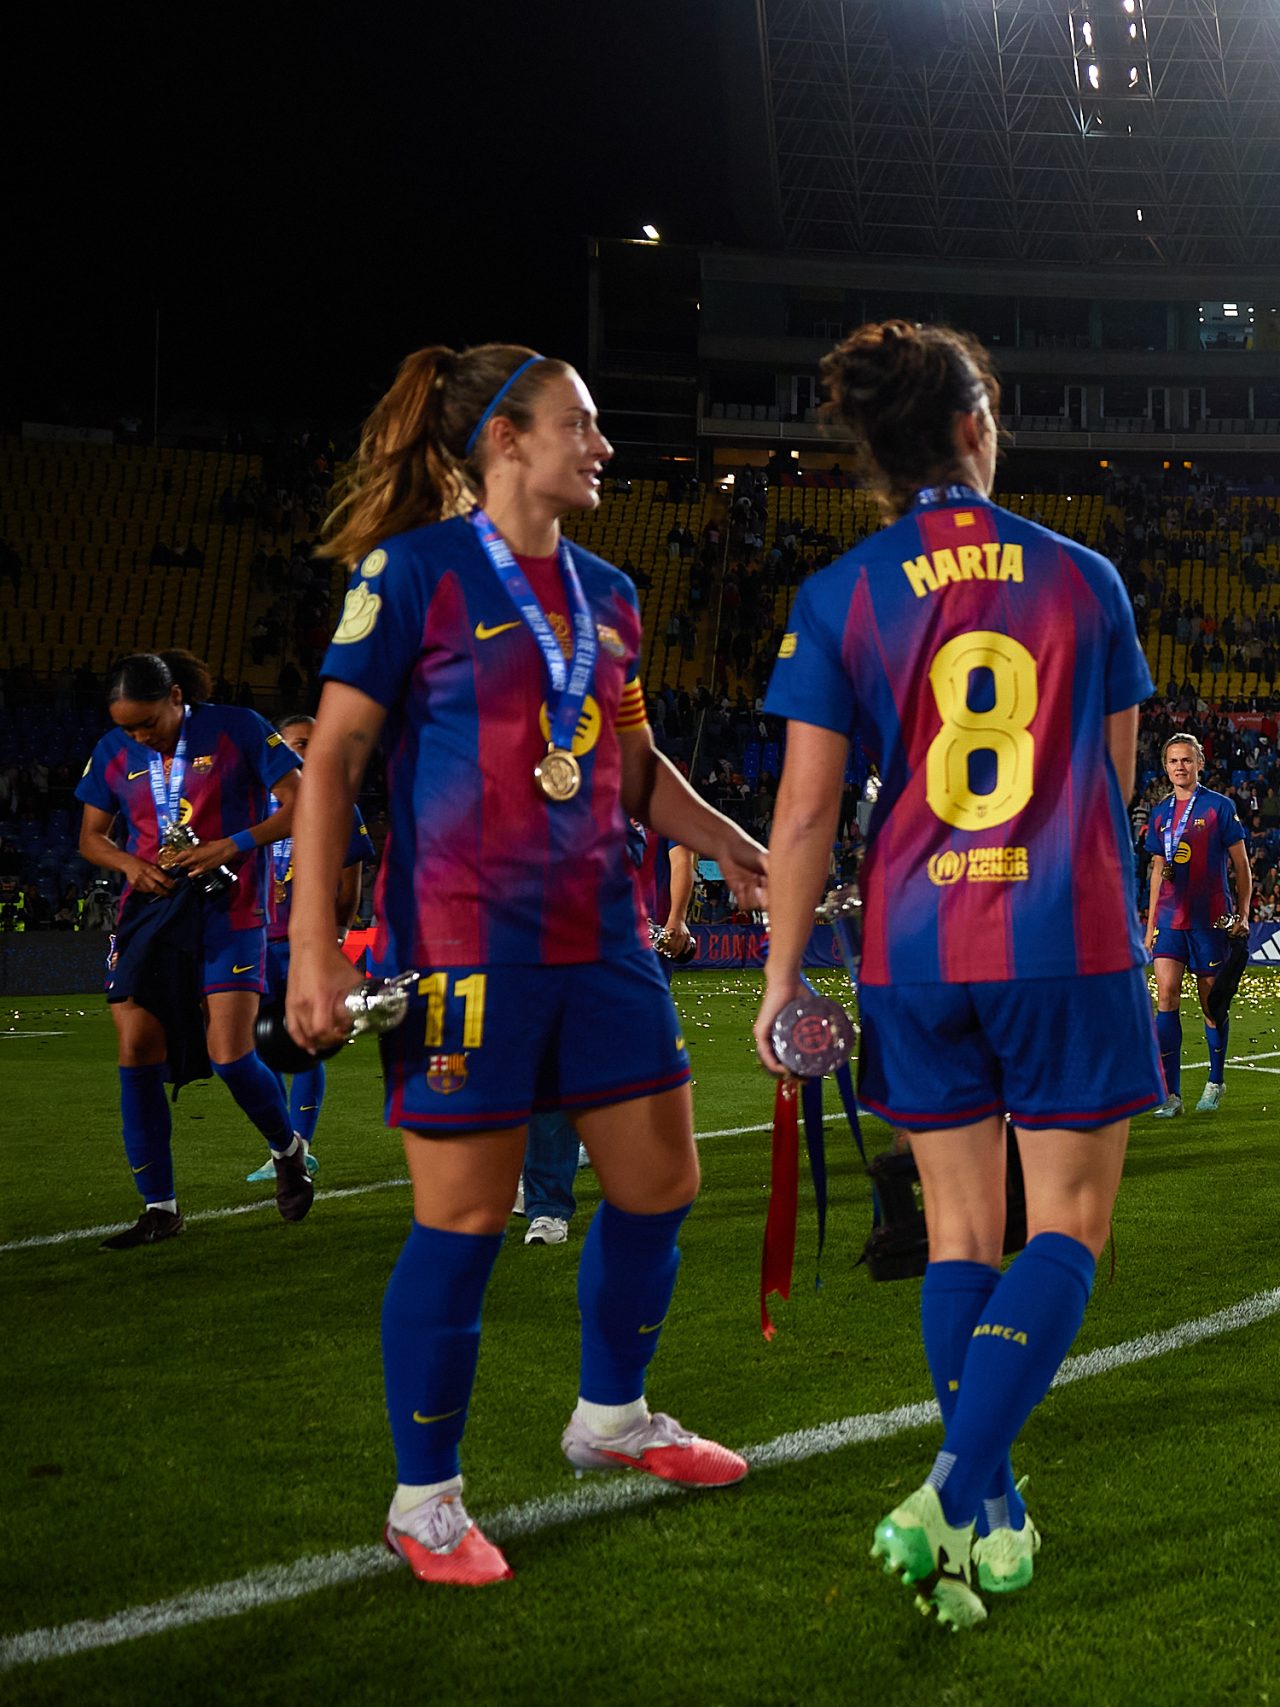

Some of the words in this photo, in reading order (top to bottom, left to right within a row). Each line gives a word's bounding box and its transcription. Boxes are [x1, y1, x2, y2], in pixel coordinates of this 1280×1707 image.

[901, 542, 1024, 599] MARTA
[925, 629, 1039, 832] 8
[967, 846, 1028, 862] UNHCR
[967, 861, 1029, 876] ACNUR
[417, 971, 487, 1048] 11
